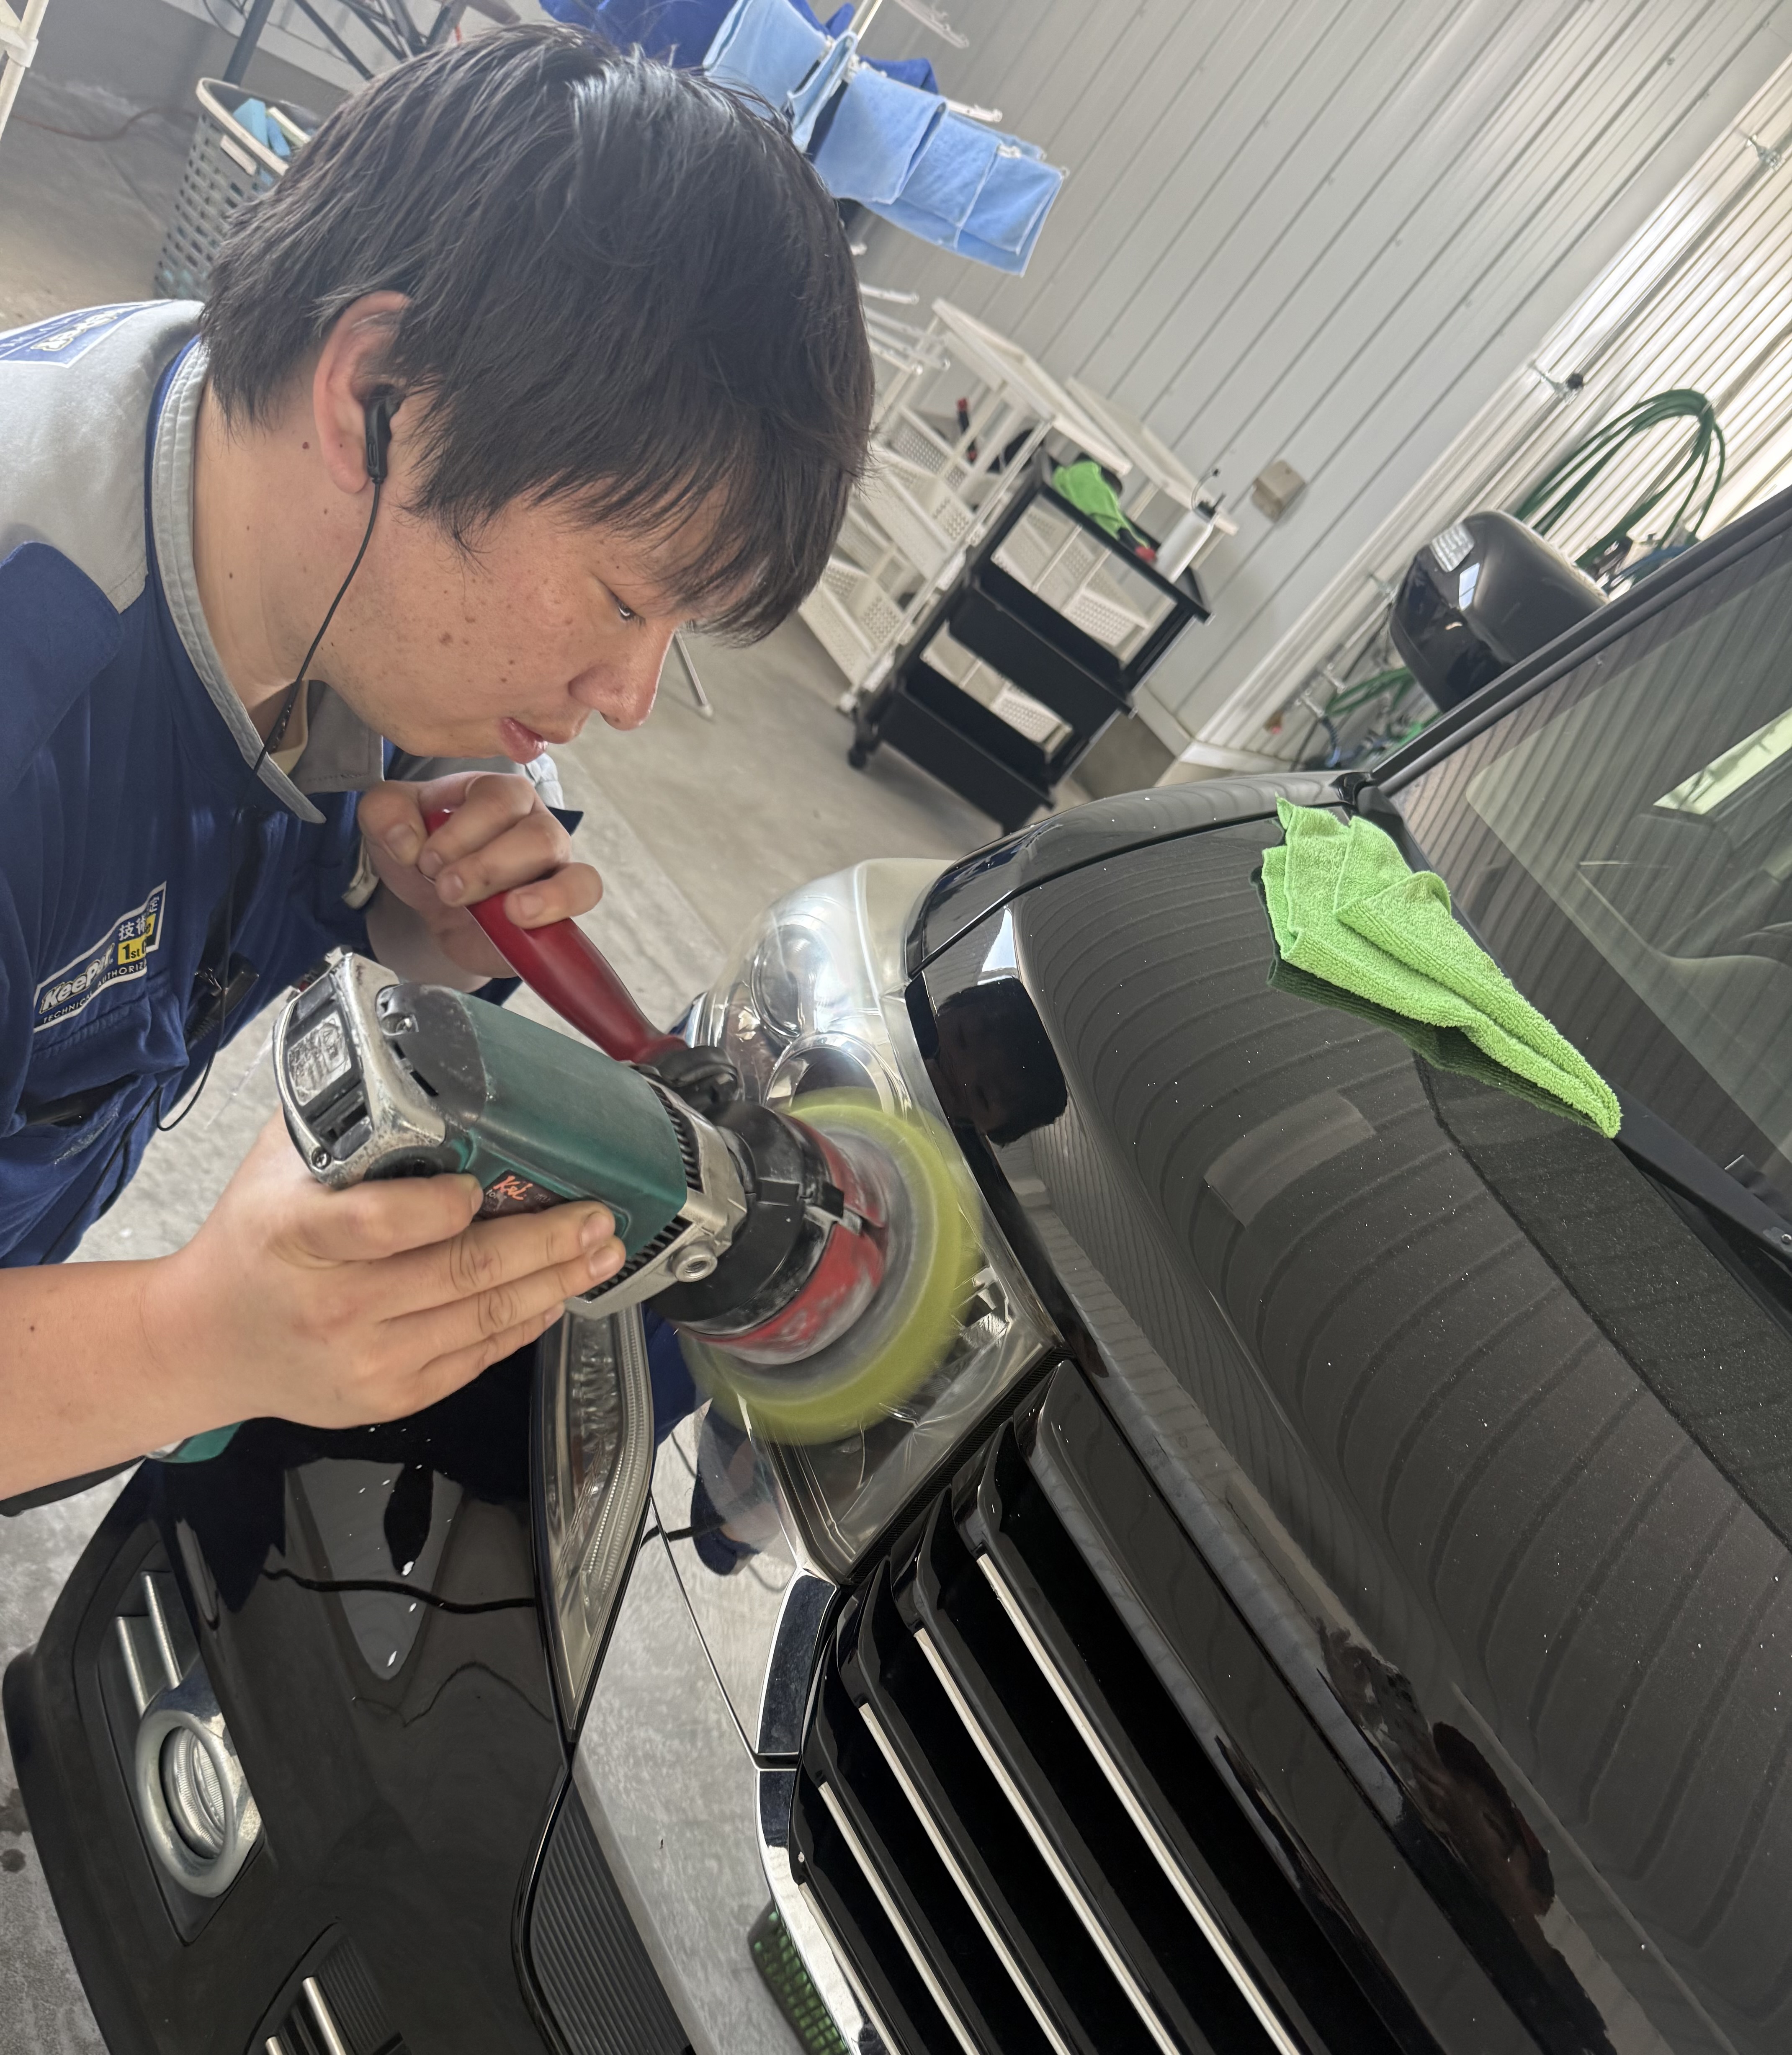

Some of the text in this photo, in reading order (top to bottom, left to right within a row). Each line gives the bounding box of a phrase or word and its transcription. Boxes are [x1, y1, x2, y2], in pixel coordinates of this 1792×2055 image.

[119, 896, 159, 941] 技術定
[122, 944, 140, 960] 1st
[98, 960, 147, 989] AUTHORIZ
